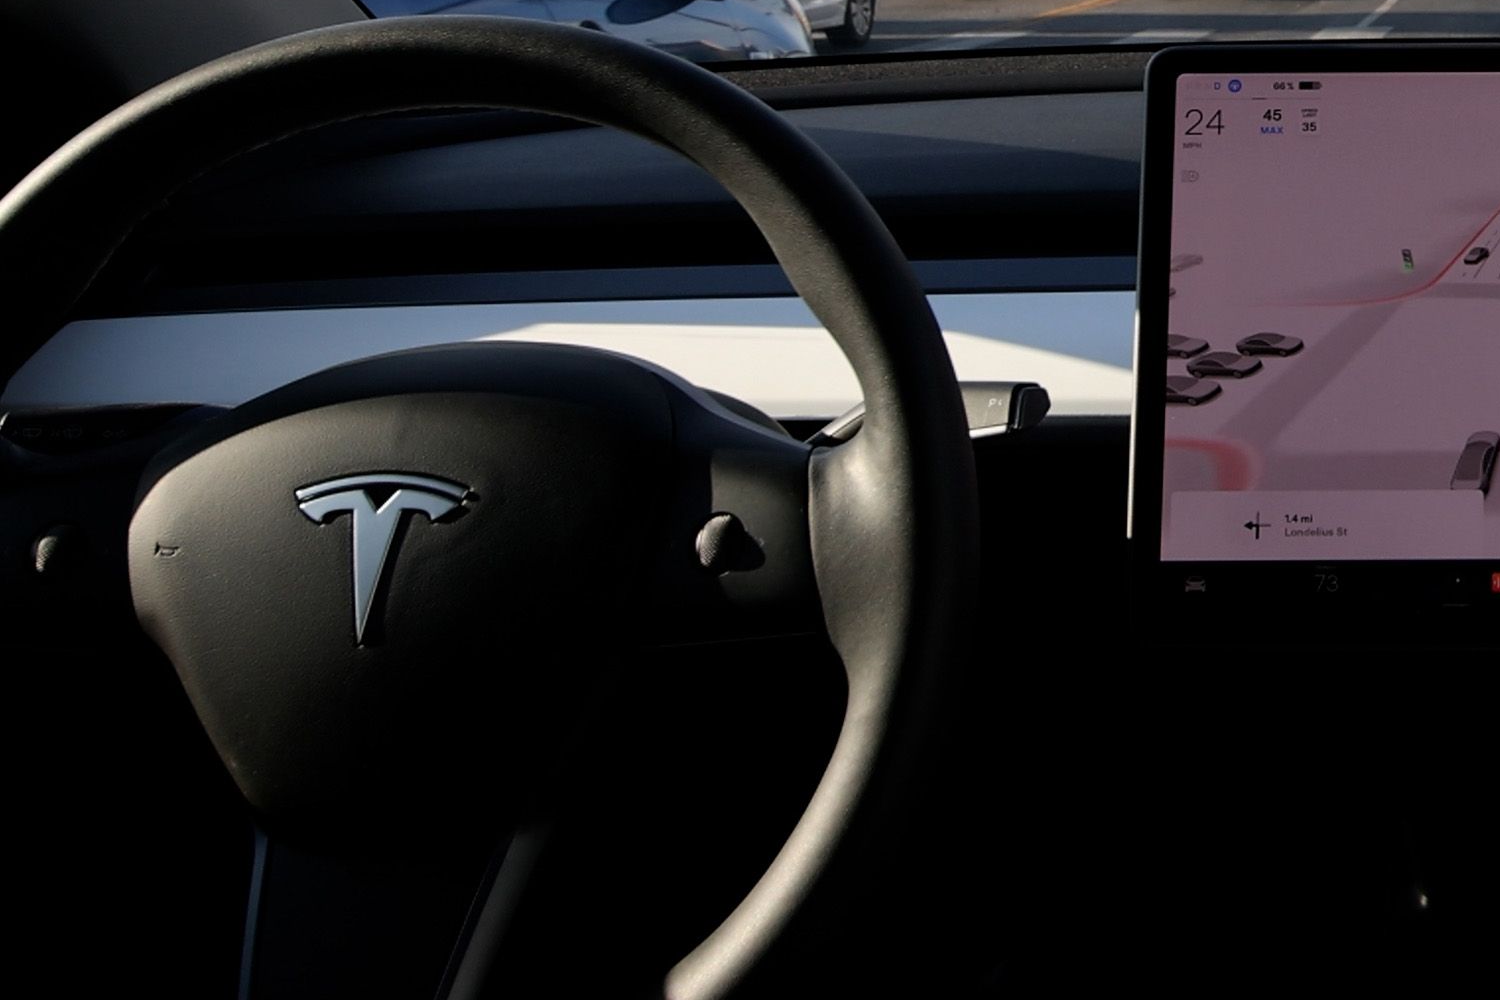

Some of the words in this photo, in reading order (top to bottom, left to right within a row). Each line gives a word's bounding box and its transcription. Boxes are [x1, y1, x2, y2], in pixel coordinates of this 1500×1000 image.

[1263, 109, 1282, 121] 45
[1185, 109, 1224, 135] 24
[1302, 122, 1317, 131] 35
[1260, 126, 1284, 134] MAX
[1284, 527, 1334, 537] Londelius
[1336, 527, 1347, 537] St
[1314, 575, 1339, 592] 73
